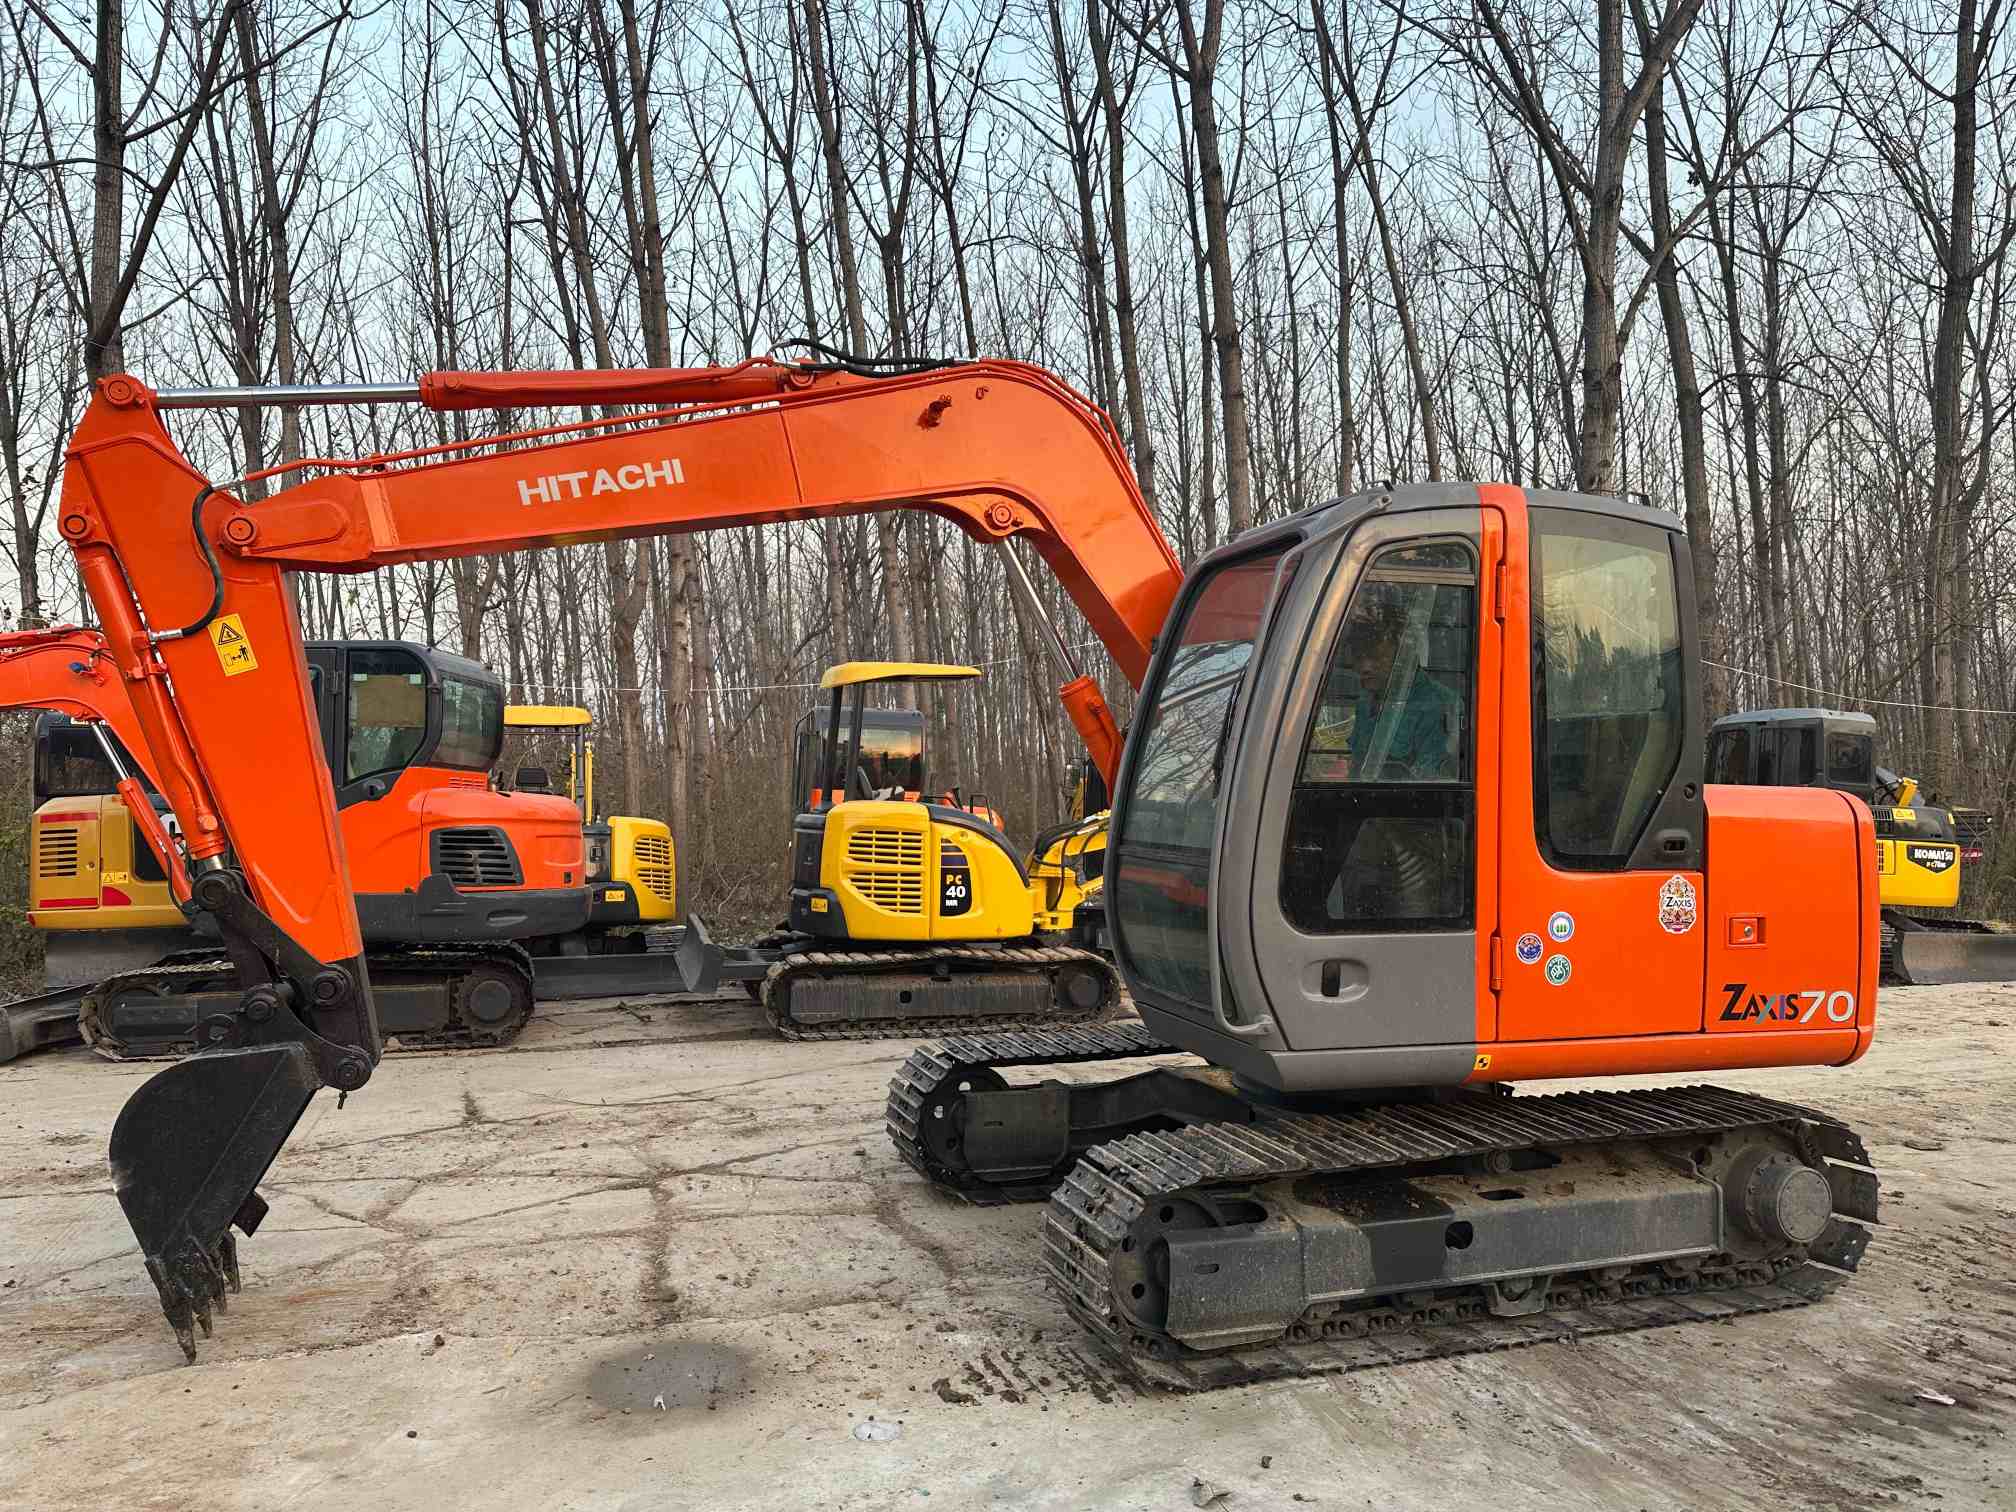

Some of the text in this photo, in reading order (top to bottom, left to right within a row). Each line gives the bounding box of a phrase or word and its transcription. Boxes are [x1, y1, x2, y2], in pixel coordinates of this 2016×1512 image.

[517, 458, 686, 506] HITACHI
[1914, 848, 1954, 861] KOMATSU
[945, 874, 963, 885] PC
[945, 885, 967, 898] 40
[1666, 896, 1692, 907] ZAXIS
